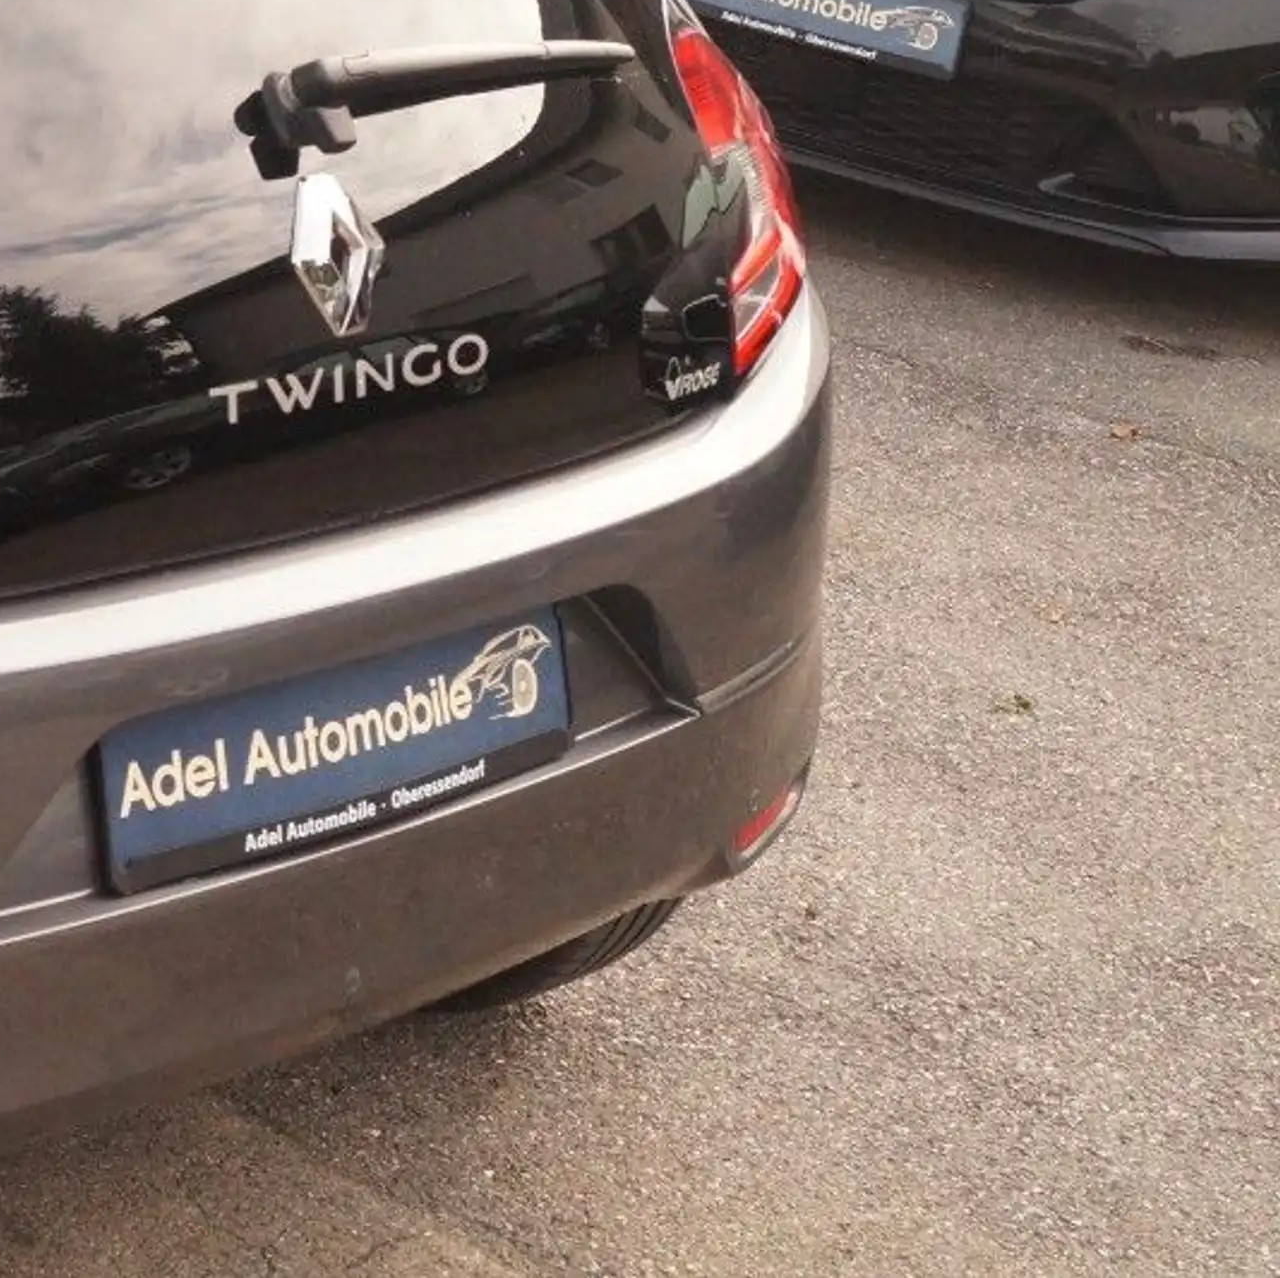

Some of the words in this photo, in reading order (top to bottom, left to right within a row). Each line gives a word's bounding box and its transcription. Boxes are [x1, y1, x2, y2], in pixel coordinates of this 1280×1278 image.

[208, 333, 489, 425] TWINGO
[119, 737, 230, 819] Adel
[243, 673, 473, 787] Automobile
[244, 827, 283, 852] Adel
[286, 799, 377, 841] Automobile
[391, 758, 485, 809] Oberessendorf
